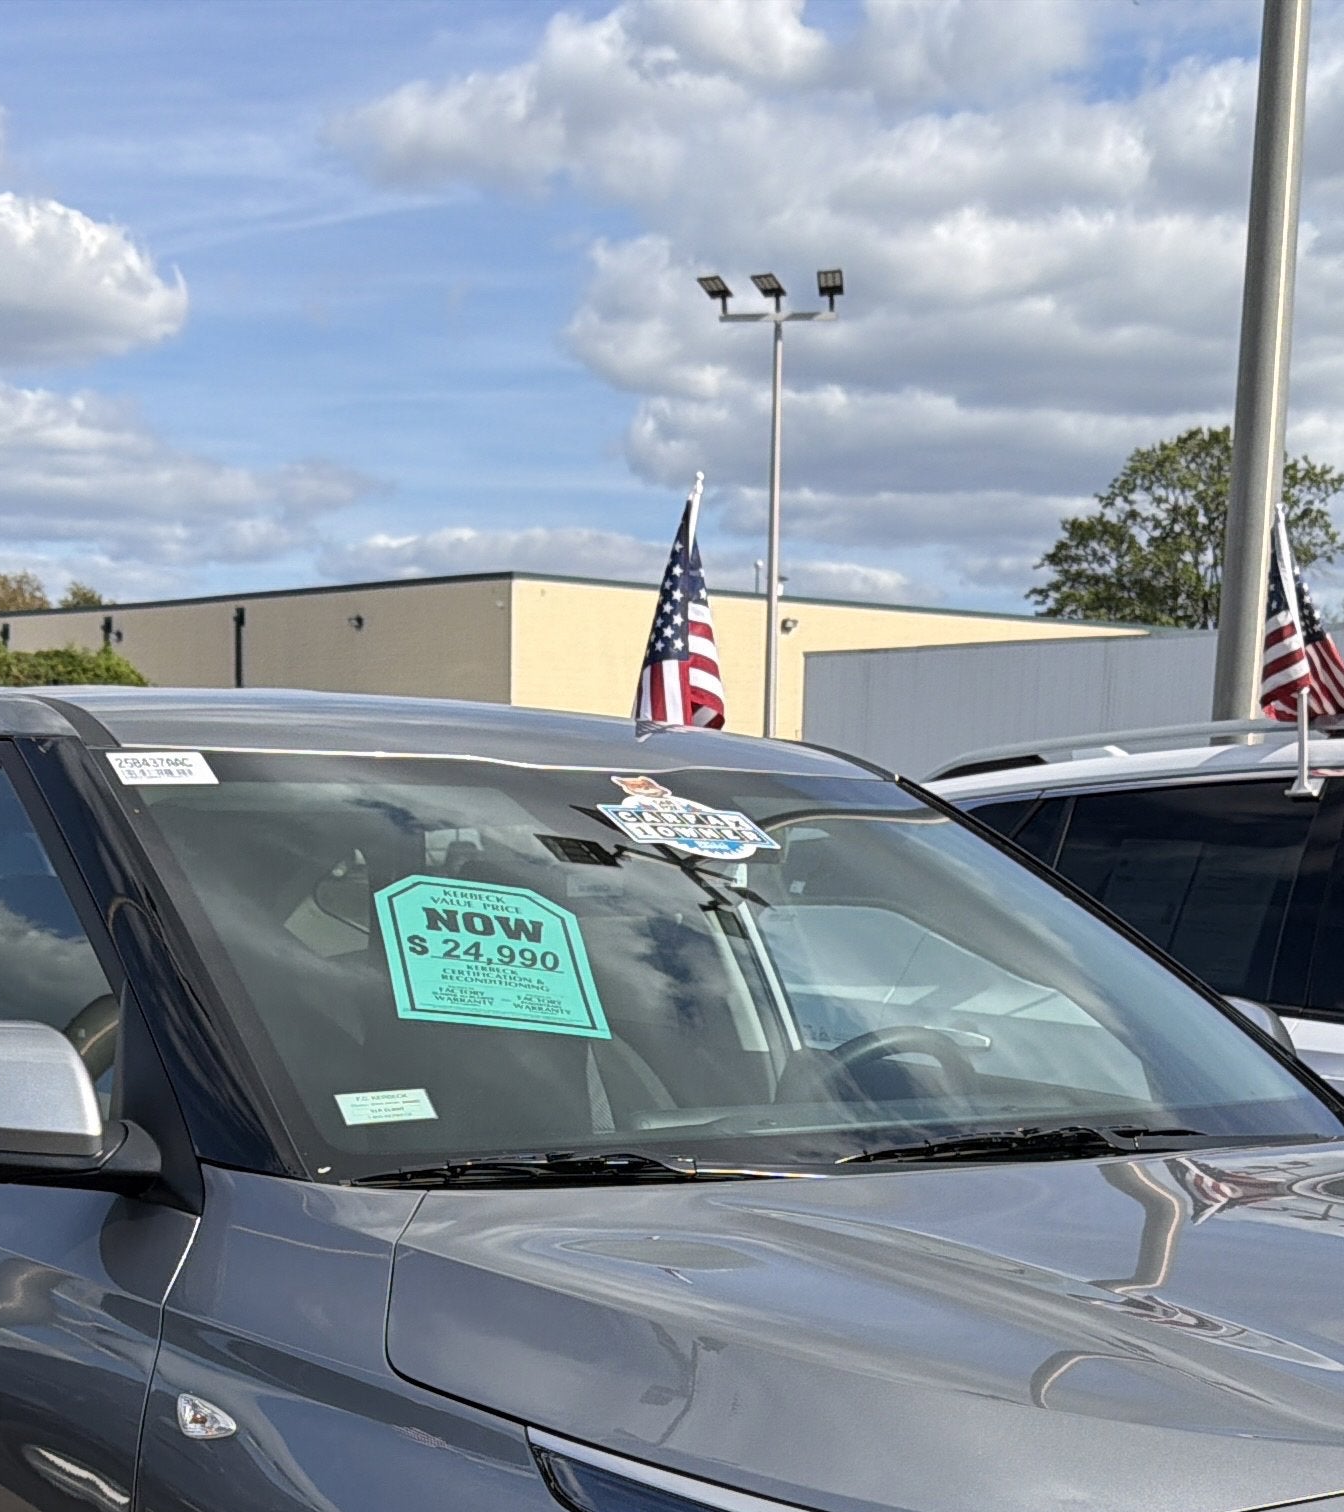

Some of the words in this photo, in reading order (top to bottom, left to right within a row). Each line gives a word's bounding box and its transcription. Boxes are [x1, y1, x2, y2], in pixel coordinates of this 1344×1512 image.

[655, 825, 762, 843] OWNER
[430, 896, 473, 909] VALUE
[482, 902, 523, 915] PRICE
[442, 888, 506, 904] KERBECK
[422, 906, 544, 944] NOW
[407, 934, 430, 956] $
[441, 938, 560, 971] 24,990
